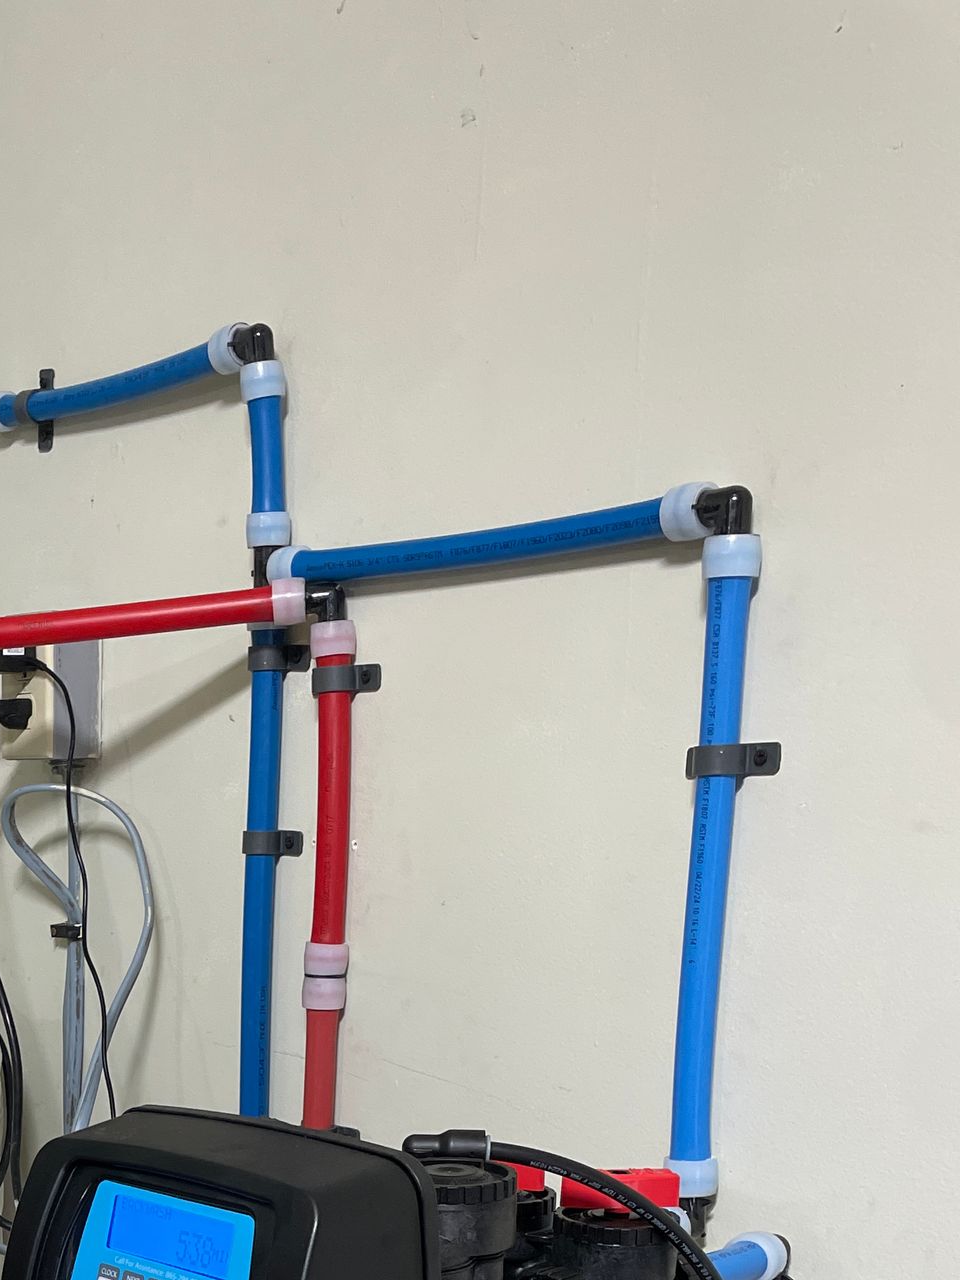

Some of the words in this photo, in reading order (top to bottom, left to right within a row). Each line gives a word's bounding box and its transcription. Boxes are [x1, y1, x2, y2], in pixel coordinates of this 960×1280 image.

[709, 671, 718, 685] 160
[706, 723, 715, 736] 100
[701, 797, 710, 820] F1807
[699, 823, 708, 841] ASTM
[696, 843, 706, 865] F1960
[100, 1267, 118, 1279] CLOCK
